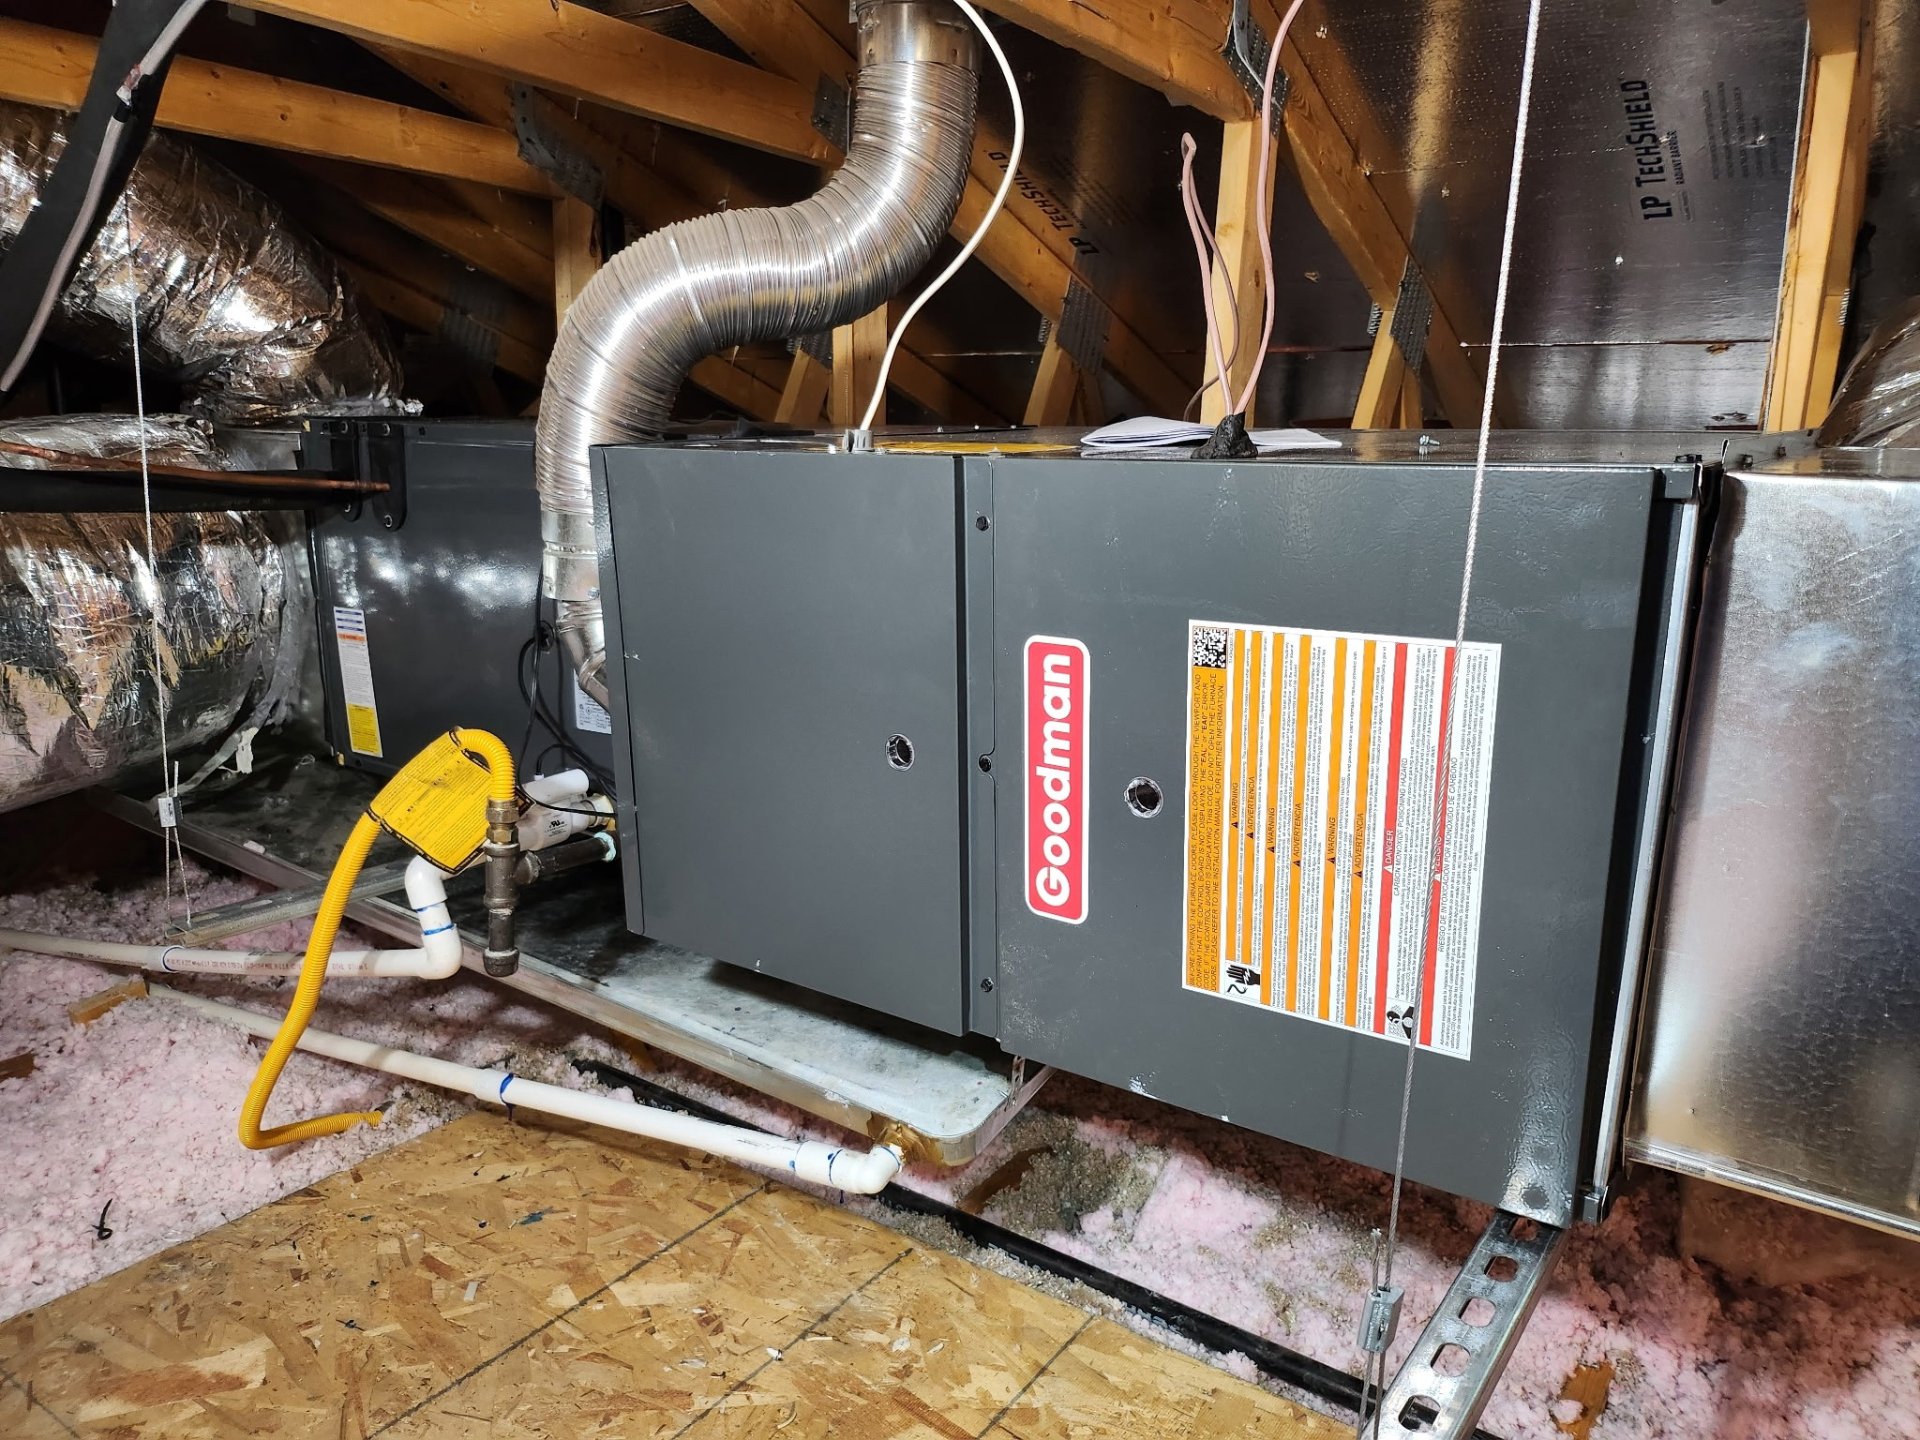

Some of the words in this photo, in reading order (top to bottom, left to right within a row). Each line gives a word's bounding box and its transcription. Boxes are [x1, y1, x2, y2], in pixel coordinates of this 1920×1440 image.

[1641, 195, 1674, 221] LP
[1069, 236, 1100, 255] LP
[1036, 654, 1072, 907] Goodman
[1207, 769, 1213, 781] DO
[1399, 757, 1407, 786] HAZARD
[1247, 775, 1255, 829] ADVERTENCIA
[1397, 787, 1406, 827] POISONING
[1292, 802, 1301, 857] ADVERTENCIA
[1327, 816, 1335, 855] WARNING
[1354, 812, 1363, 868] ADVERTENCIA
[1385, 829, 1393, 863] DANGER
[1395, 828, 1403, 865] MONOXIDE
[1212, 827, 1220, 879] INSTALLATION
[1393, 867, 1401, 896] CARBON
[1437, 925, 1445, 952] RIESGO
[1443, 846, 1451, 862] POR
[1212, 896, 1218, 907] TO
